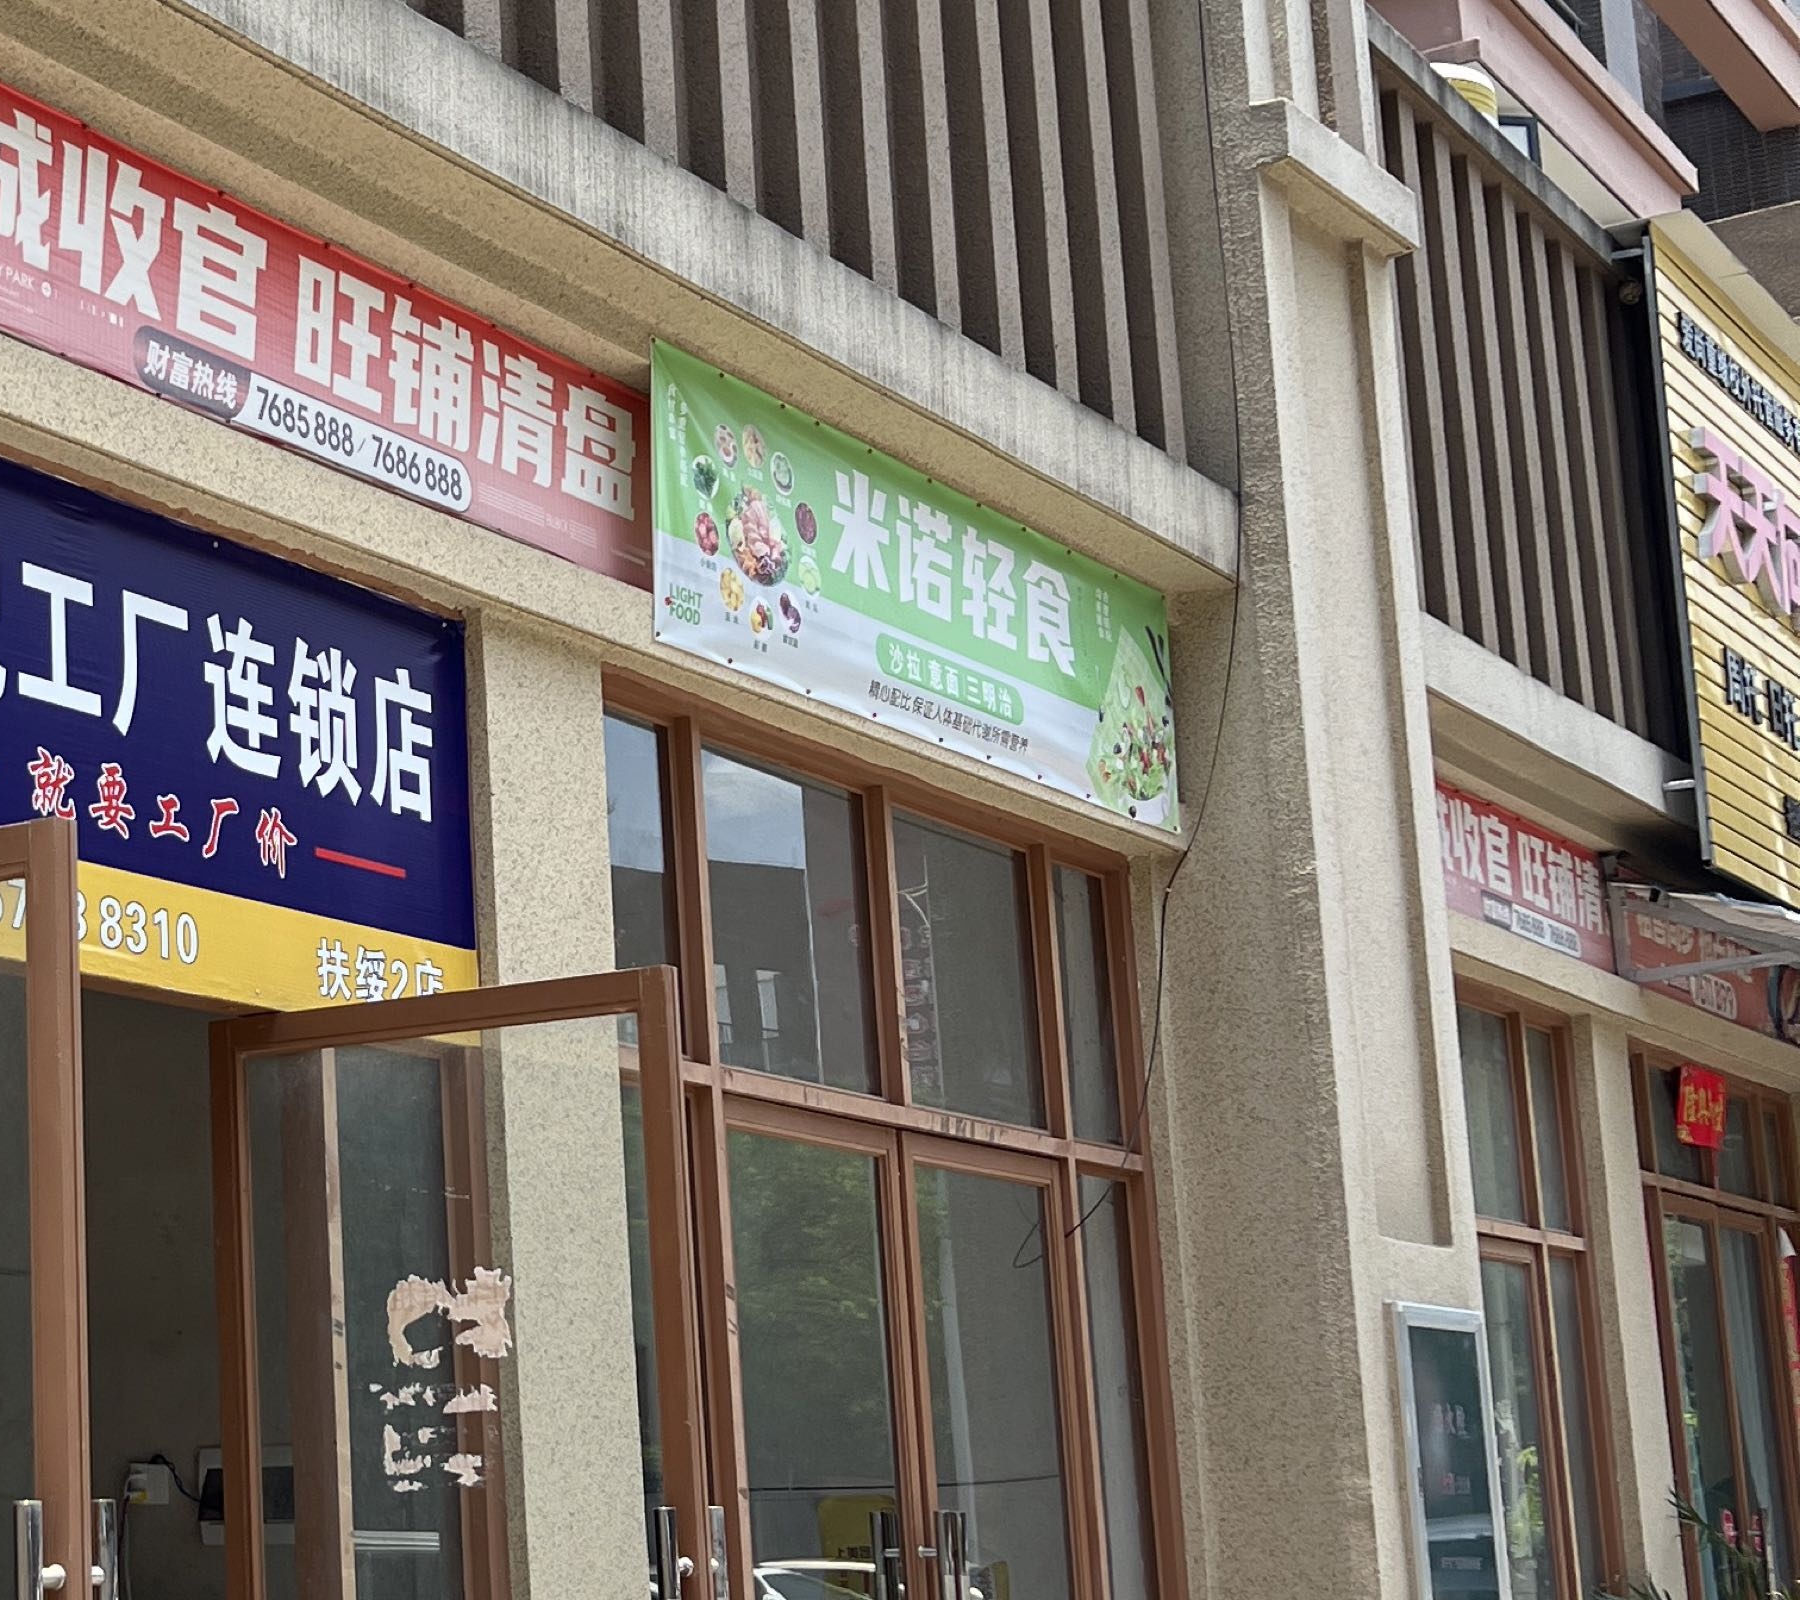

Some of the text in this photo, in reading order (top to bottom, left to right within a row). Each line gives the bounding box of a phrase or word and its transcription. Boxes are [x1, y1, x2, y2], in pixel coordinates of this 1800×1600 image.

[5, 266, 36, 292] PARK
[143, 339, 239, 410] 财富热线
[293, 254, 637, 521] 旺铺清盘
[669, 583, 704, 609] LIGHT
[830, 468, 1076, 678] 米诺轻食
[669, 603, 701, 626] FOOD
[888, 642, 1014, 720] 沙拉 意面 三明治
[99, 894, 199, 965] 8310
